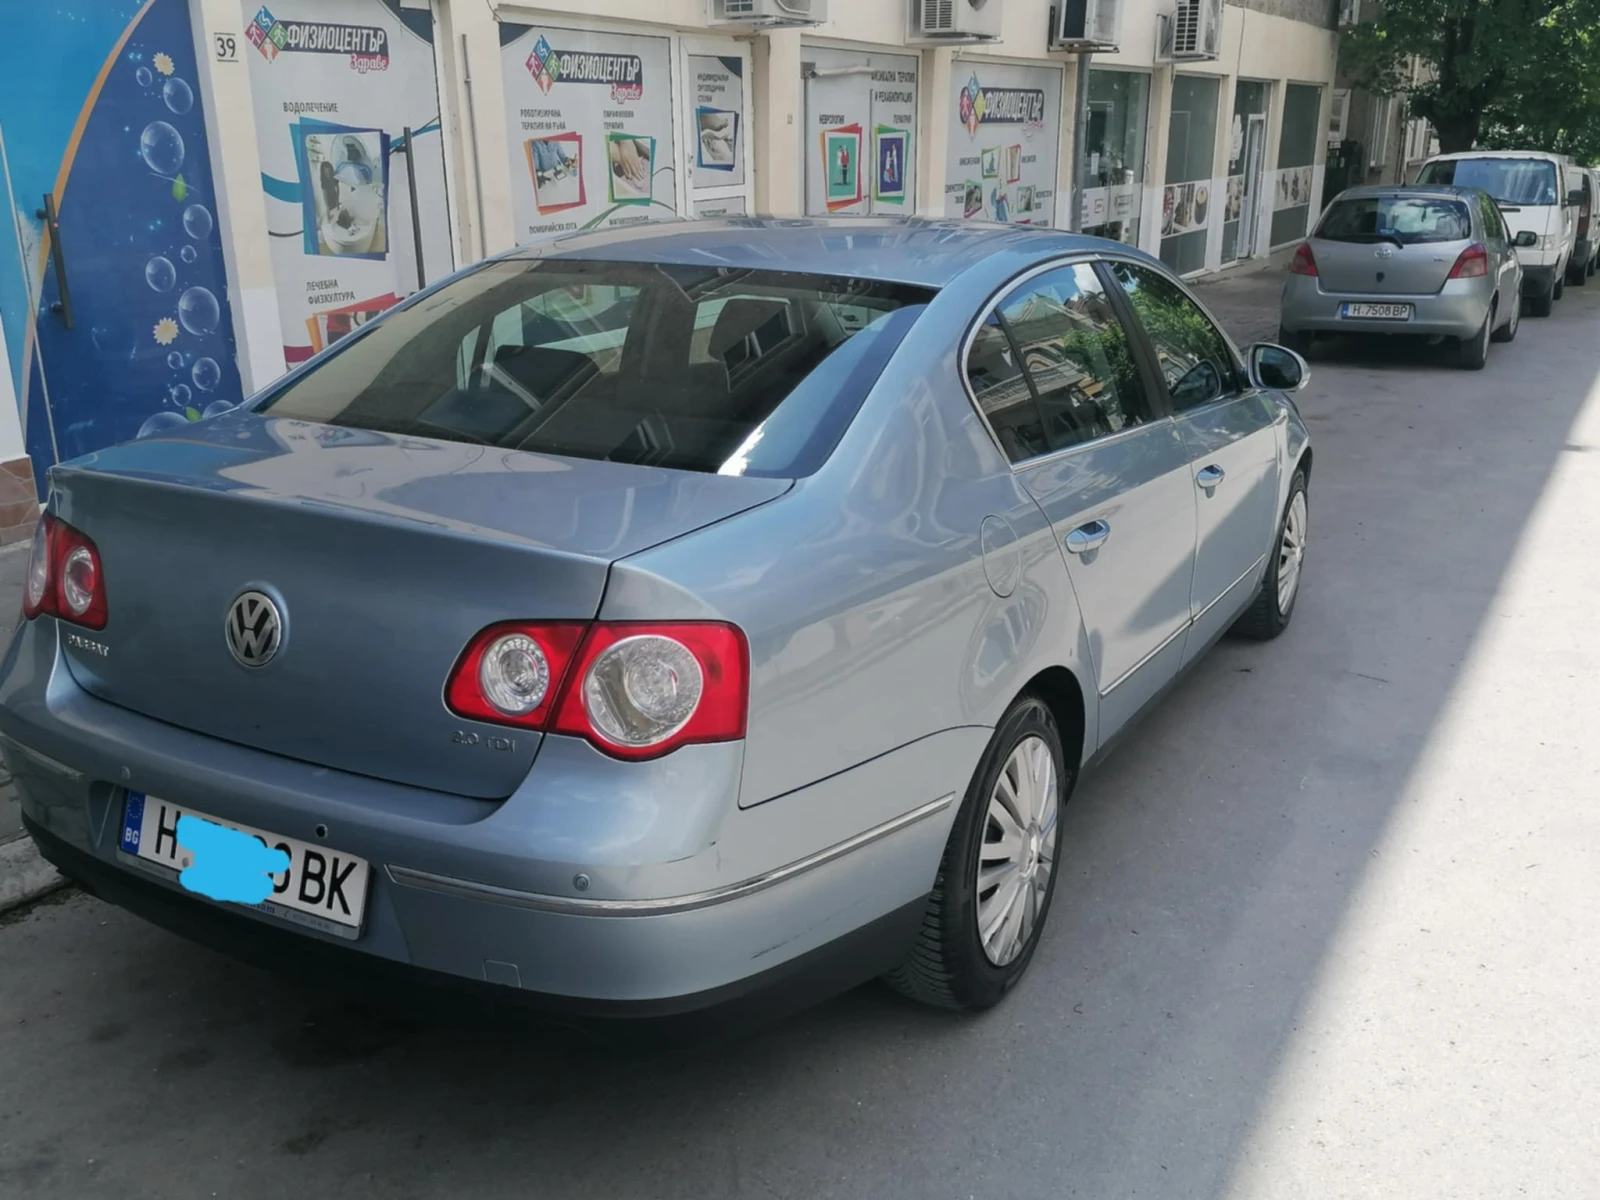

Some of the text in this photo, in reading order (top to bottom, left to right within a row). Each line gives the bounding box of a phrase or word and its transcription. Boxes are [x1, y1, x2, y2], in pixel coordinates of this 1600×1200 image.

[216, 37, 236, 58] 39
[287, 25, 385, 52] ФИЗИОЦЕНТЪР
[350, 54, 387, 74] Здраве
[560, 54, 641, 82] ФИЗИОЦЕНТЪР
[611, 83, 643, 104] Здраве
[283, 101, 339, 115] ВОДОЛЕЧЕНИЕ
[306, 279, 339, 291] ЛЕЧЕБНА
[307, 291, 356, 305] ФИЗКУЛТУРА
[1365, 305, 1391, 316] 7508
[125, 827, 139, 845] BG
[298, 850, 358, 916] BK
